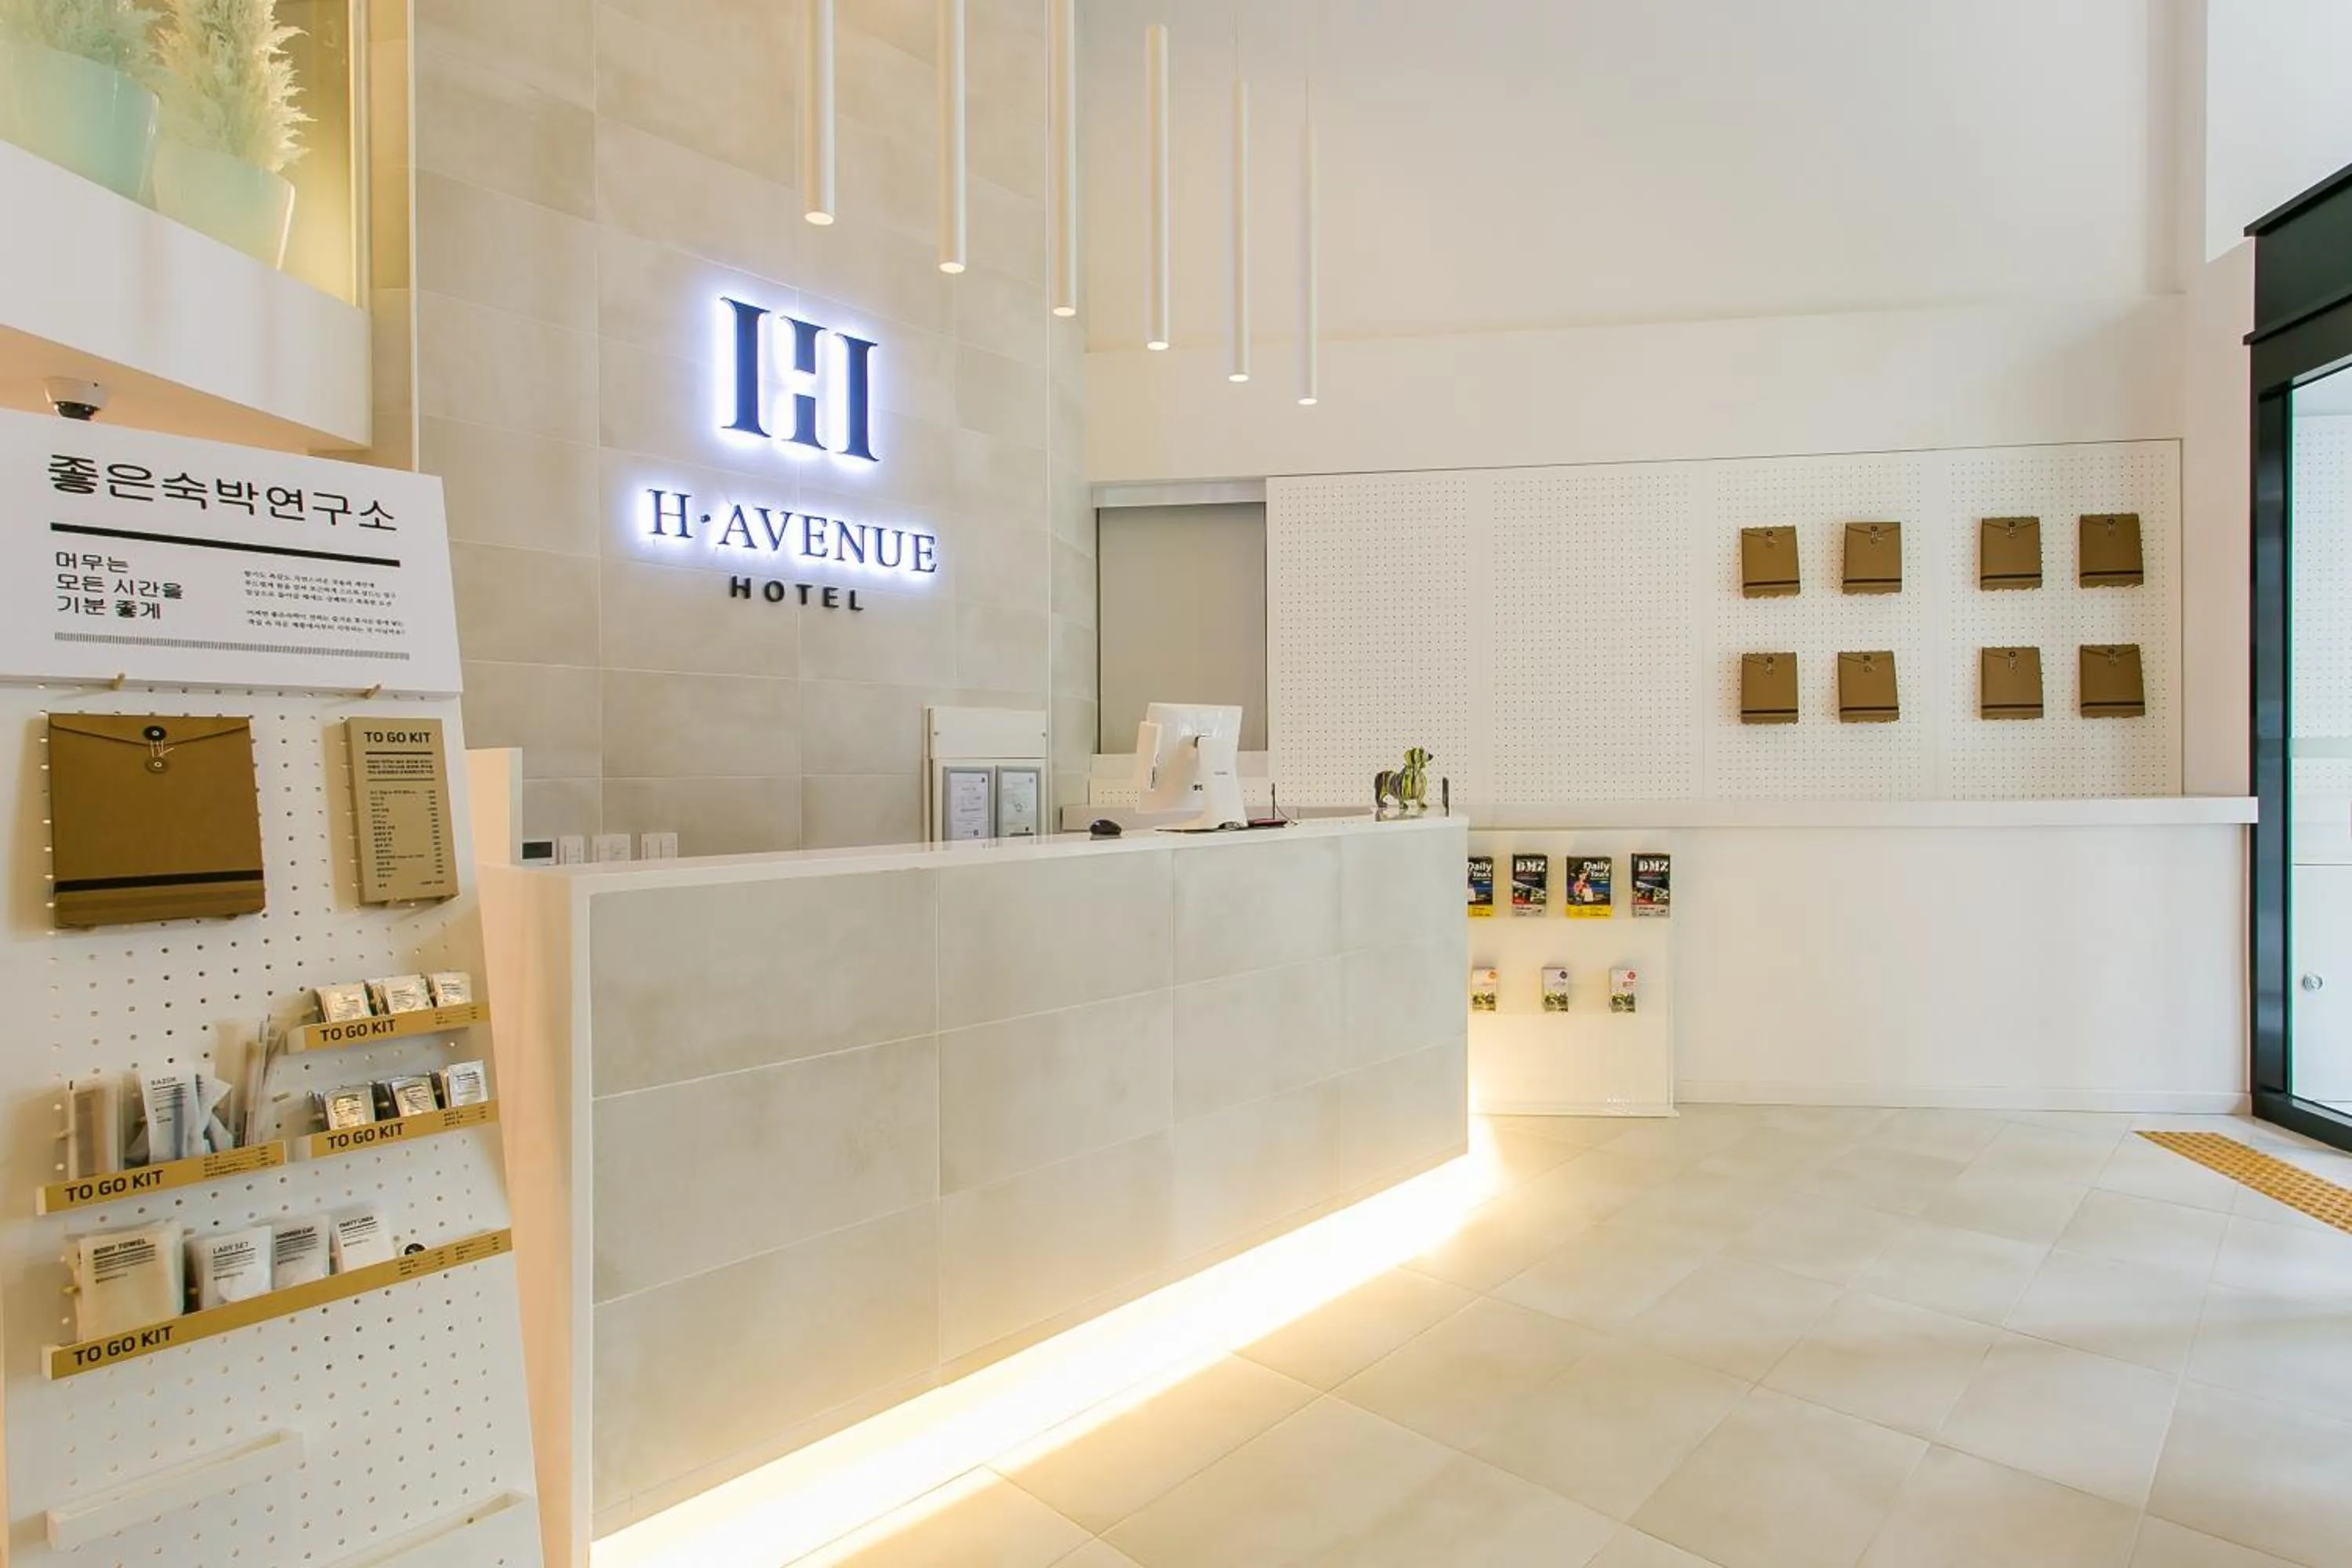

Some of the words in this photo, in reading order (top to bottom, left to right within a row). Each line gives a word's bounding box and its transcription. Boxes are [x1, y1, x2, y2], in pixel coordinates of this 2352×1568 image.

[48, 453, 397, 532] 좋은숙박연구소
[56, 550, 129, 574] 머무는
[56, 573, 105, 593] 모든
[113, 579, 183, 600] 시간을
[730, 575, 865, 612] HOTEL
[56, 596, 107, 616] 기분
[115, 600, 162, 619] 좋게
[364, 731, 383, 743] TO
[387, 731, 406, 743] GO
[408, 731, 431, 743] KIT
[1515, 860, 1545, 873] DMZ
[1584, 862, 1610, 873] Daily
[1638, 860, 1669, 873] DMZ
[320, 1028, 342, 1041] TO
[346, 1024, 368, 1039] GO
[372, 1019, 396, 1035] KIT
[327, 1134, 349, 1149] TO
[354, 1128, 376, 1144] GO
[379, 1123, 405, 1139] KIT
[65, 1185, 93, 1202] TO
[99, 1178, 126, 1196] GO
[132, 1170, 164, 1189] KIT
[73, 1346, 101, 1366] TO
[107, 1337, 136, 1356] GO
[141, 1325, 174, 1347] KIT
